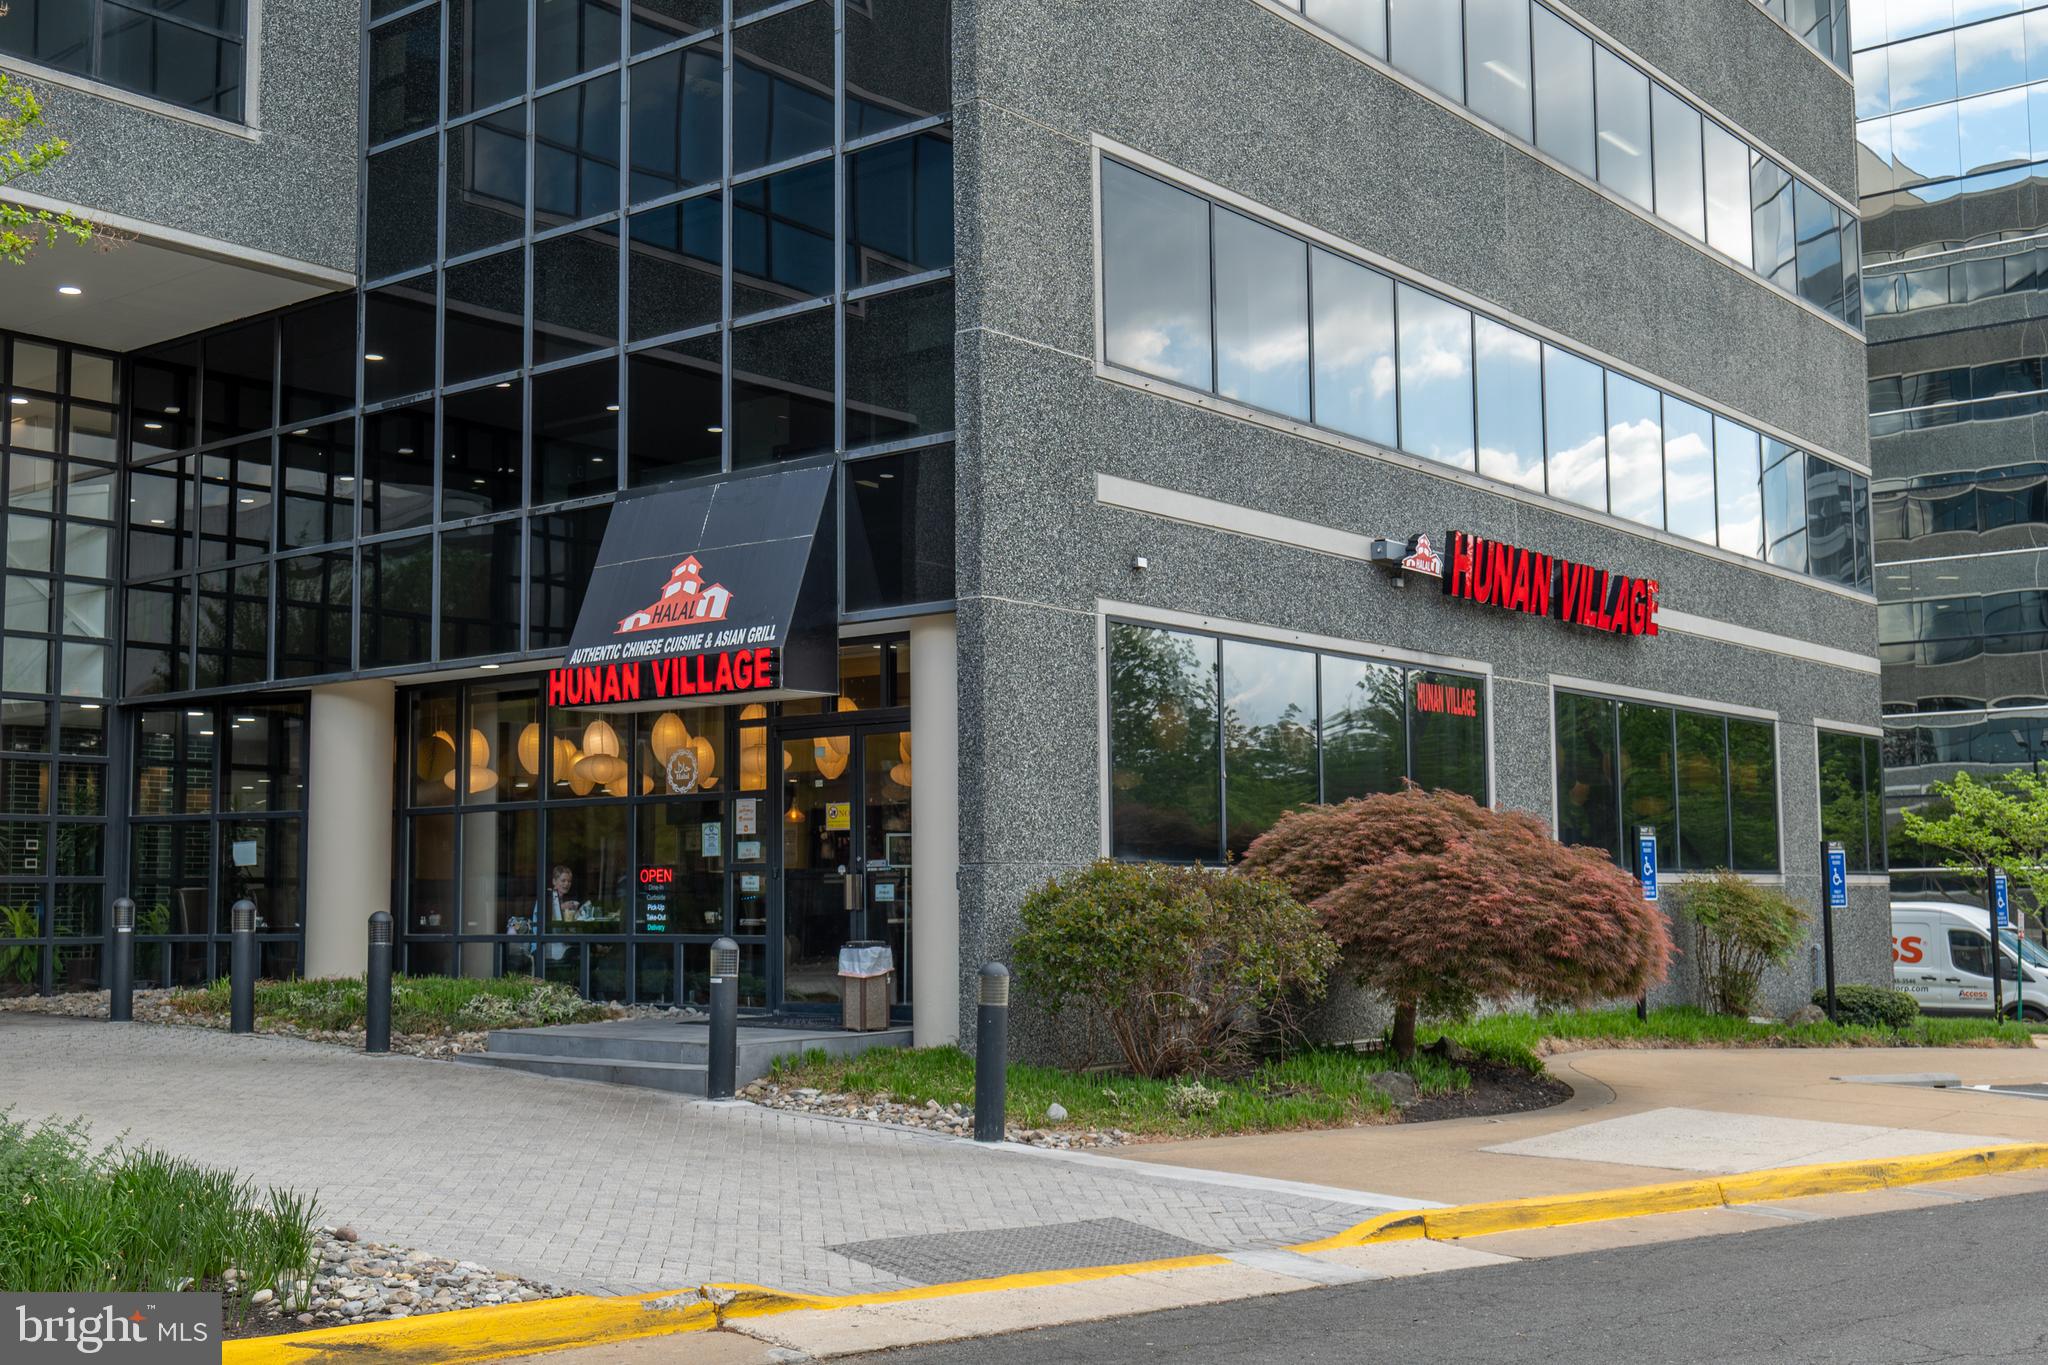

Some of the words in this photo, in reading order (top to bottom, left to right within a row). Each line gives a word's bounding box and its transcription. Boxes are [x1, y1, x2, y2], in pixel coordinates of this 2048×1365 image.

[1416, 559, 1431, 571] HALAL
[1451, 530, 1553, 617] HUNAN
[1560, 559, 1659, 636] VILLAGE
[651, 600, 696, 624] HALAL
[569, 644, 620, 664] AUTHENTIC
[622, 638, 664, 658] CHINESE
[664, 633, 703, 652] CUISINE
[704, 632, 713, 646] &
[714, 628, 747, 647] ASIAN
[747, 624, 776, 642] GRILL
[548, 662, 640, 707] HUNAN
[651, 647, 772, 697] VILLAGE
[1417, 682, 1444, 712] HUNAN
[1445, 686, 1476, 717] VILLAGE
[640, 868, 673, 883] OPEN
[1959, 990, 1988, 998] Access
